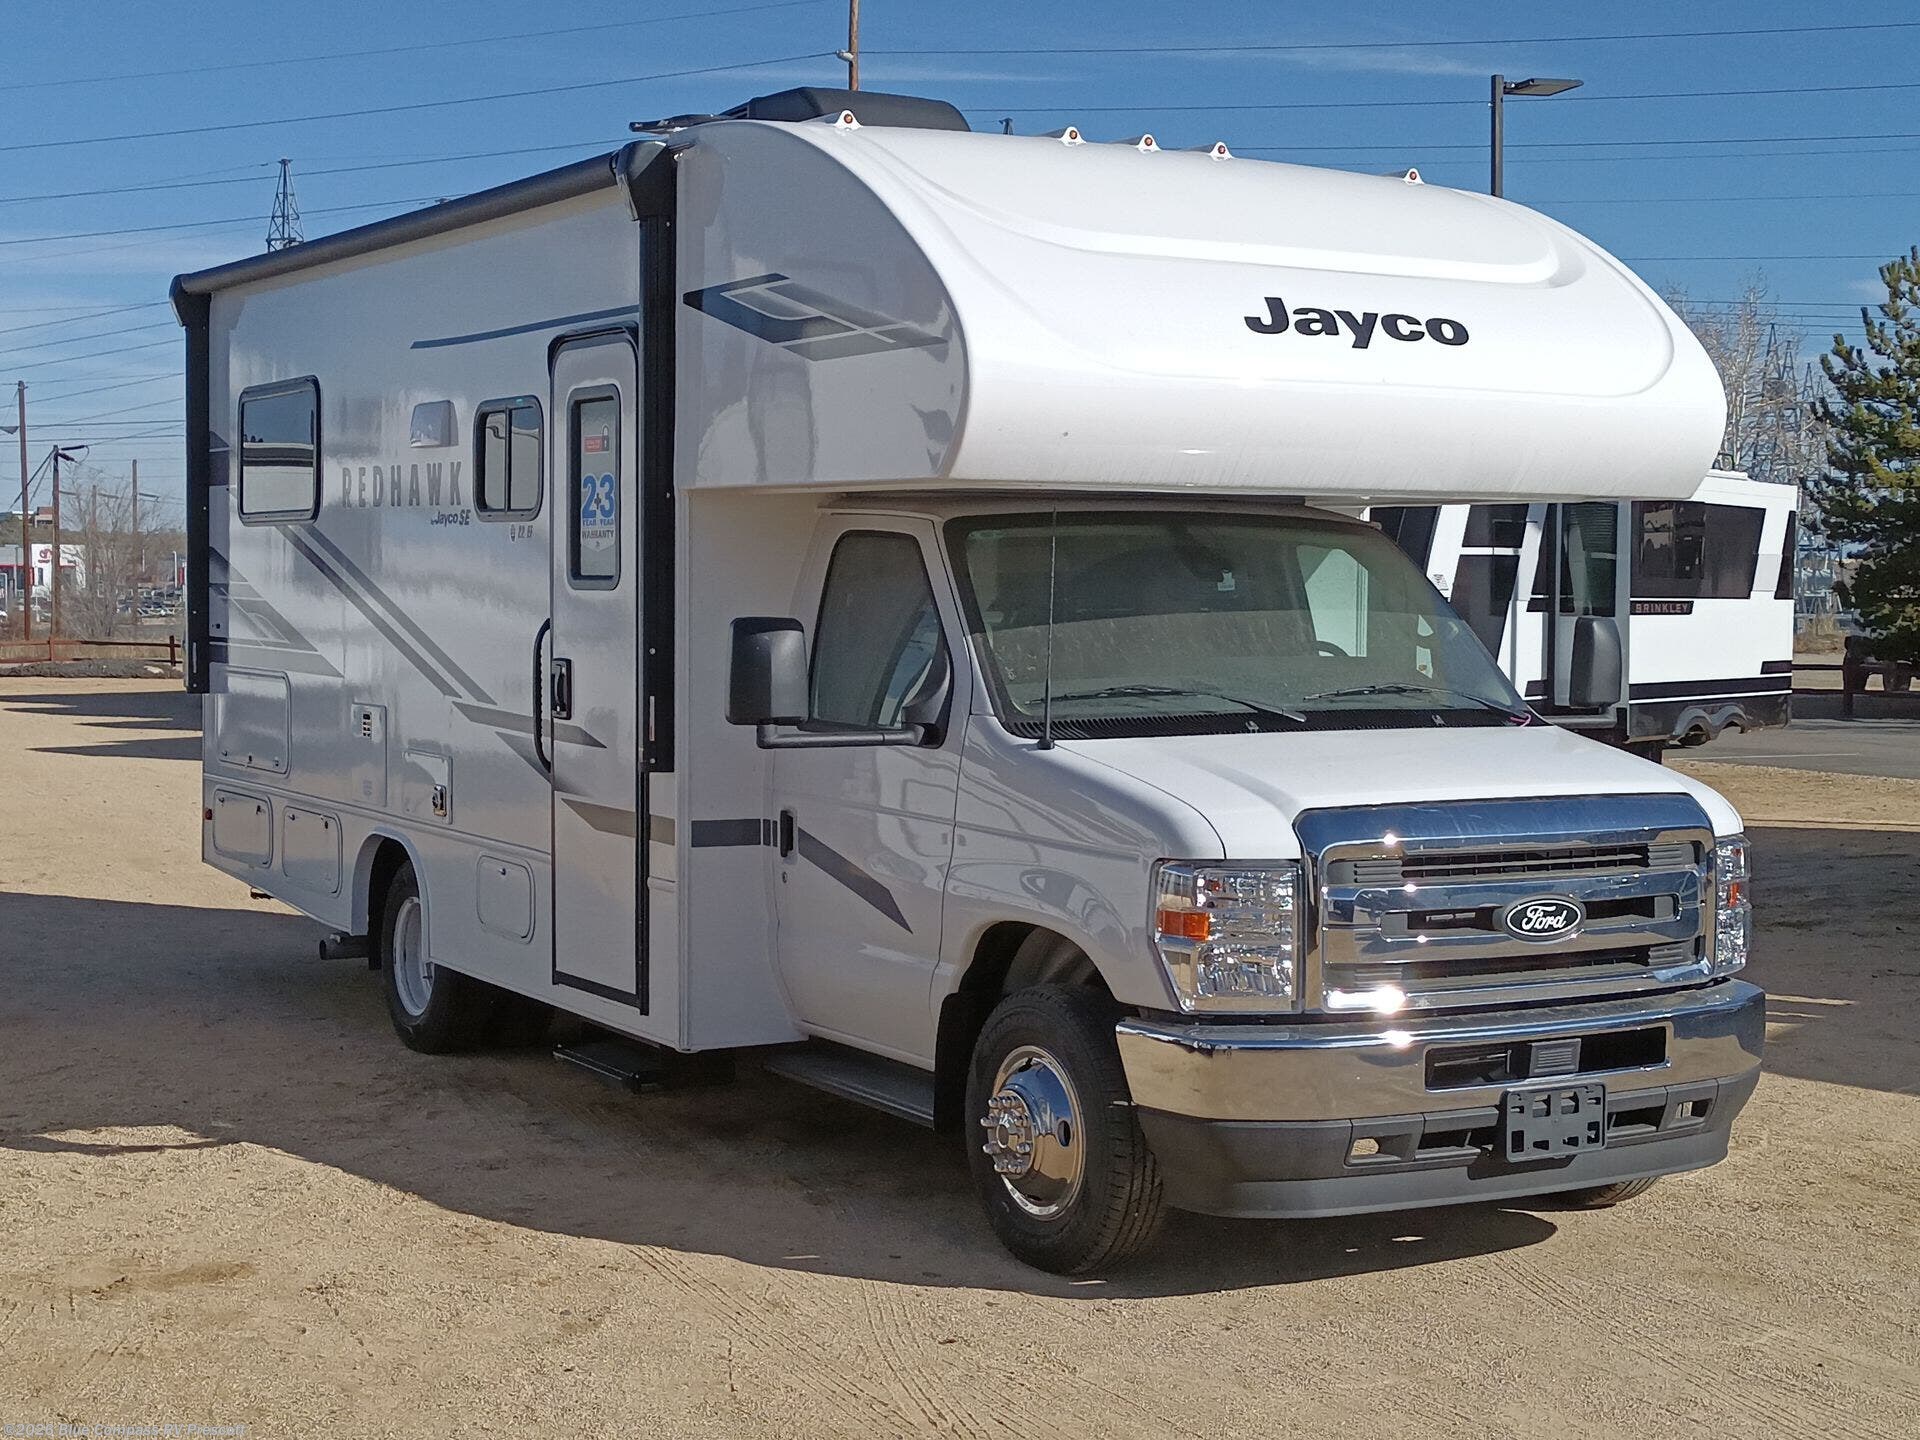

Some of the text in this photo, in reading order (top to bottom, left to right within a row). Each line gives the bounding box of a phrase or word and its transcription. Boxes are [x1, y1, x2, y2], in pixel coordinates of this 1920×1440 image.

[1243, 296, 1470, 349] Jayco
[342, 461, 462, 508] REDHAWK
[436, 510, 458, 527] Jayco
[459, 509, 471, 525] SE
[582, 530, 615, 539] WARRANTY
[1635, 603, 1688, 613] BRINKLEY
[1521, 905, 1568, 930] Ford
